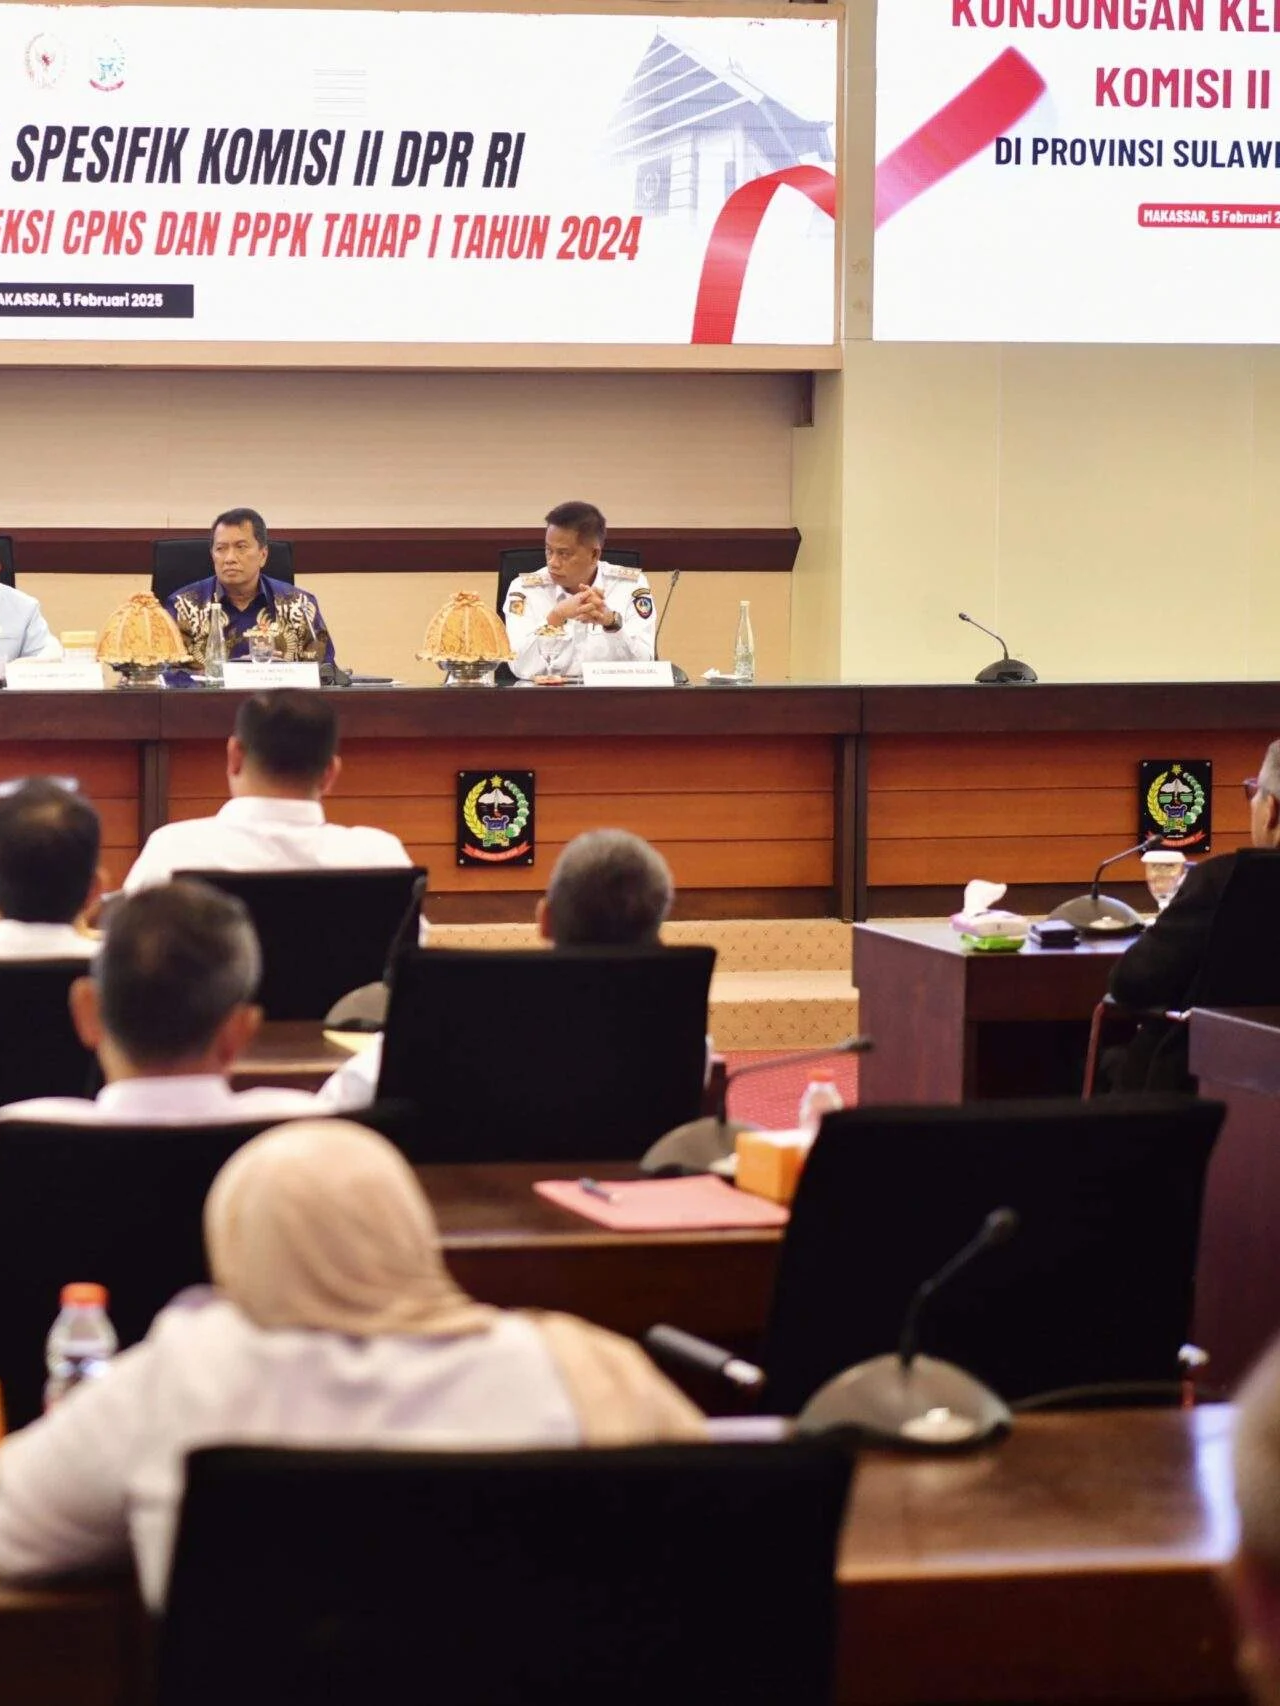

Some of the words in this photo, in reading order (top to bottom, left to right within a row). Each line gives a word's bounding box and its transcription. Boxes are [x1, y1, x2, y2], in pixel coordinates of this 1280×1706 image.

[951, 0, 1205, 31] KUNJUNGAN
[1220, 0, 1280, 32] KE
[1096, 67, 1232, 109] KOMISI
[1248, 69, 1270, 110] II
[11, 125, 190, 184] SPESIFIK
[198, 128, 346, 186] KOMISI
[353, 130, 384, 187] II
[392, 131, 475, 188] DPR
[482, 132, 526, 189] RI
[995, 136, 1022, 166] DI
[1032, 137, 1163, 168] PROVINSI
[1144, 209, 1209, 225] MAKASSAR,
[1212, 210, 1220, 224] 5
[1223, 210, 1272, 224] Februari
[63, 210, 147, 256] CPNS
[155, 211, 222, 256] DAN
[228, 212, 313, 257] PPPK
[323, 213, 422, 258] TAHAP
[428, 214, 442, 259] I
[451, 215, 551, 260] TAHUN
[557, 216, 643, 261] 2024
[63, 292, 71, 307] 5
[74, 292, 129, 307] Februari
[131, 292, 164, 307] 2025
